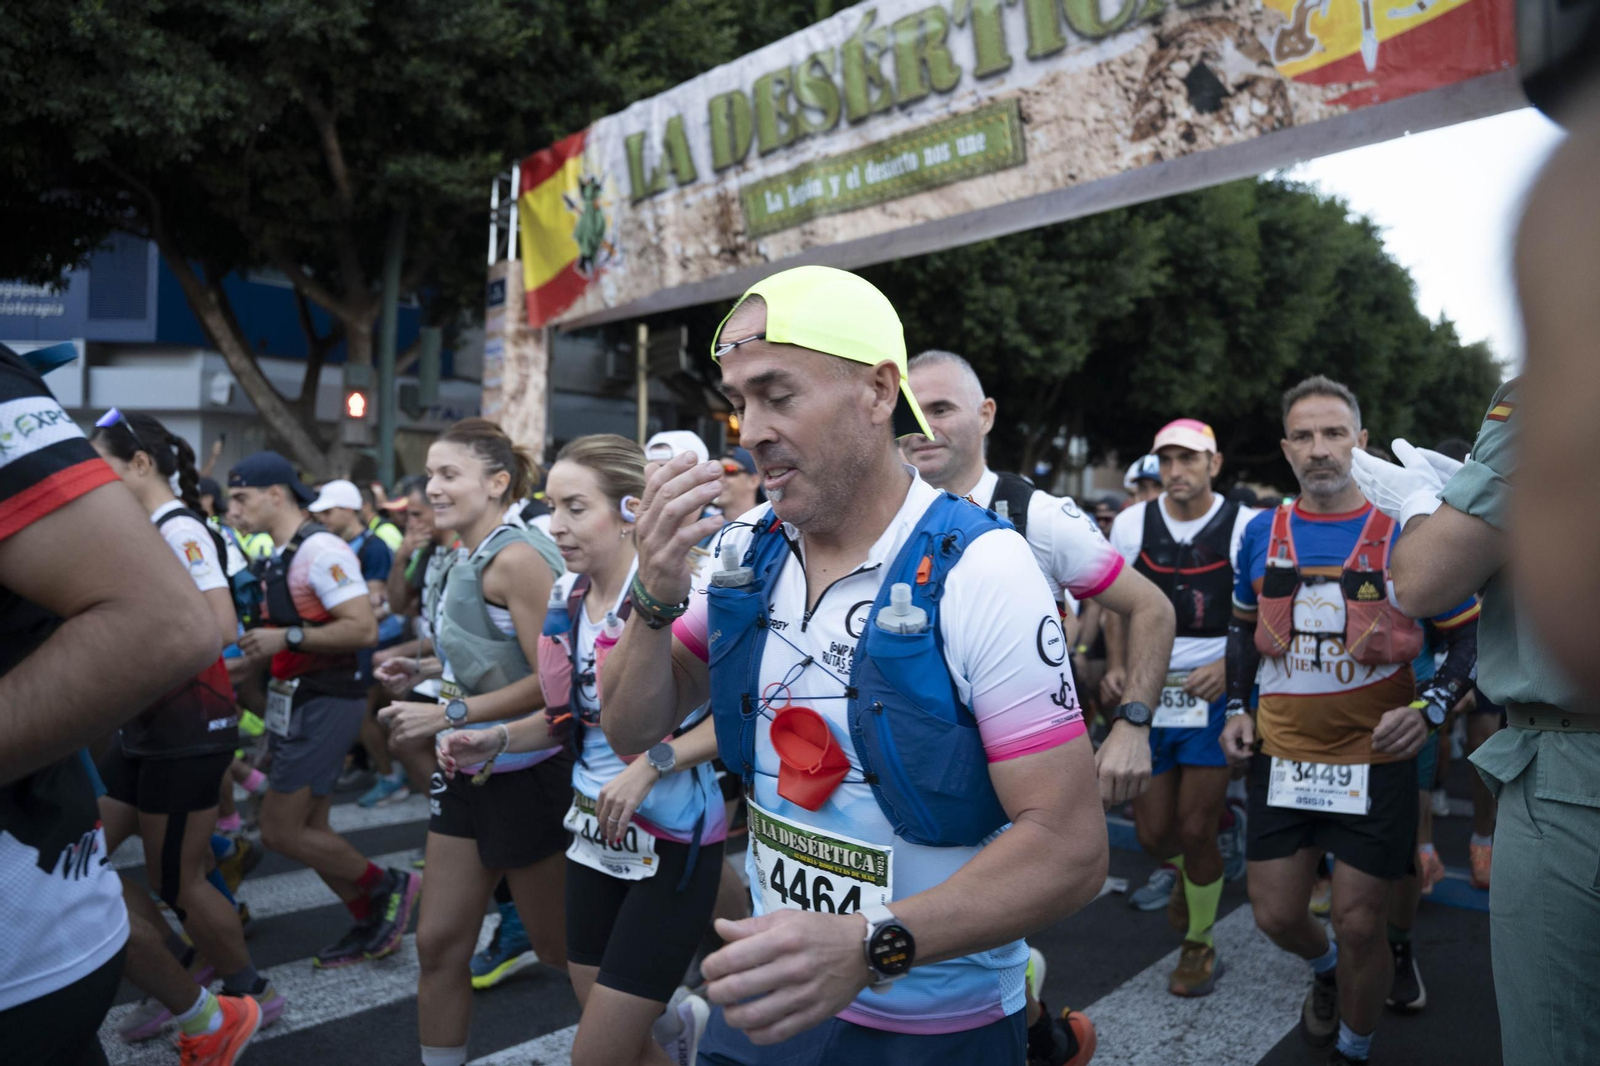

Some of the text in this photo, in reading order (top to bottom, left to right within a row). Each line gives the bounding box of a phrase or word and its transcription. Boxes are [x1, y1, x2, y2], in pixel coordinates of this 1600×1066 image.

[624, 0, 1211, 206] LA DESÉRTI
[764, 189, 785, 214] La
[828, 175, 841, 199] y
[846, 165, 861, 190] el
[864, 152, 919, 184] desierto
[923, 143, 951, 167] nos
[955, 132, 987, 158] une
[1291, 761, 1352, 787] 3449
[580, 818, 639, 854] 440
[760, 818, 778, 842] LA
[777, 826, 877, 874] DESÉRTICA
[770, 857, 862, 916] 4464
[876, 855, 885, 877] 2025
